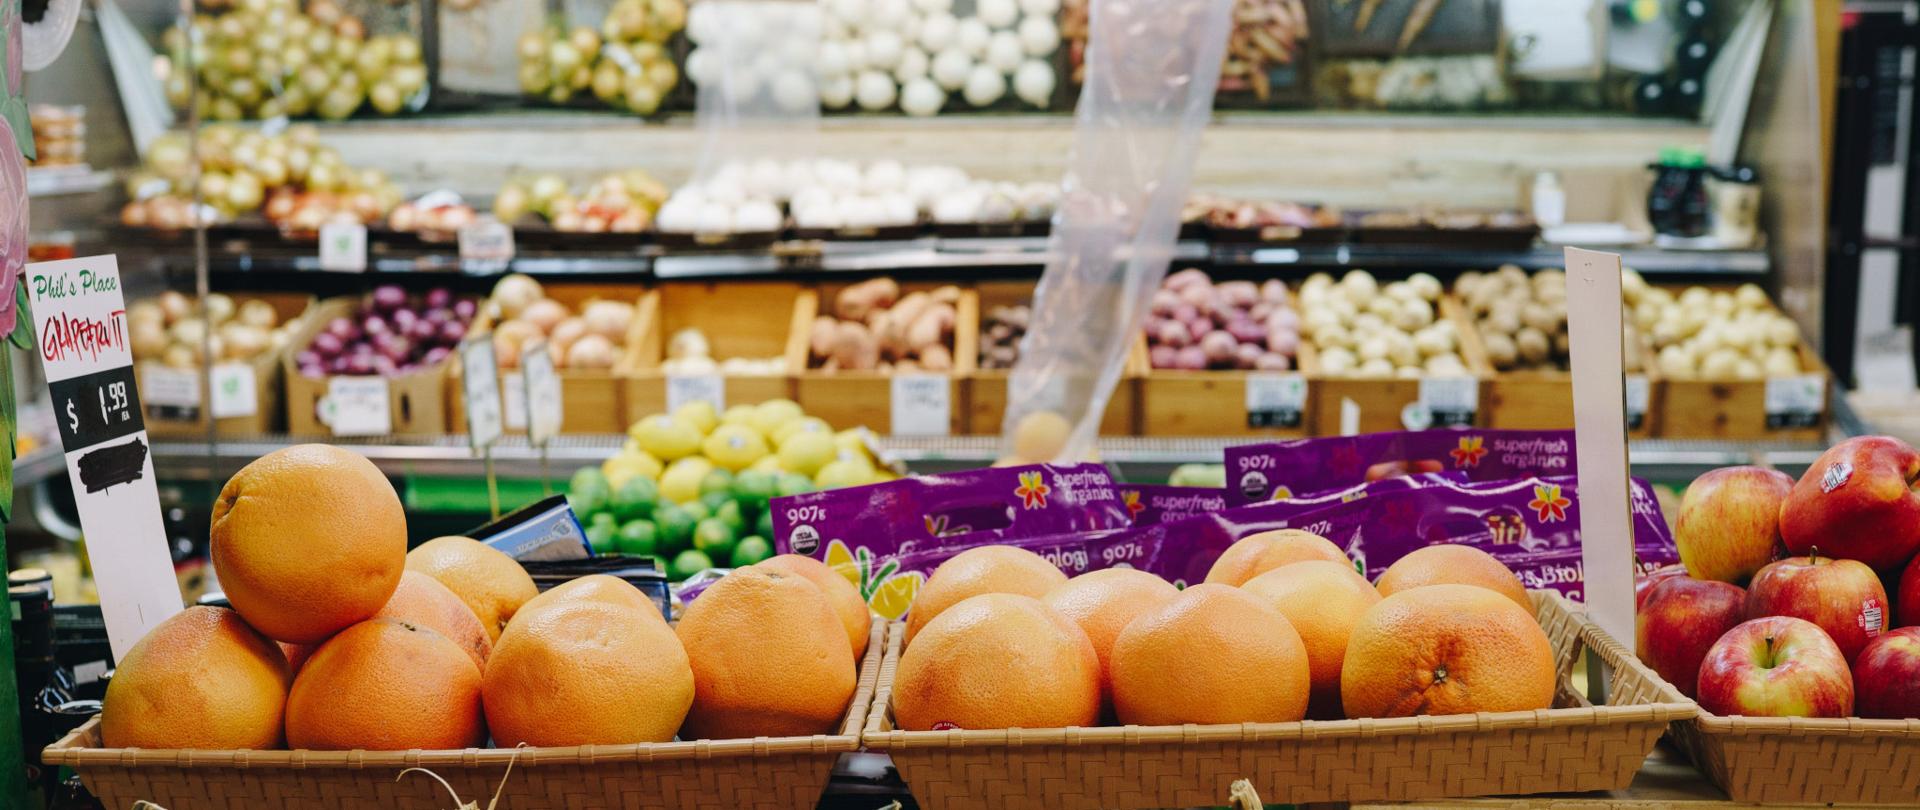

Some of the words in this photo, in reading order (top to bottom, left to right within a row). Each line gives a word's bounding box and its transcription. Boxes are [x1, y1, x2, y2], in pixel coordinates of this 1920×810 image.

[33, 272, 77, 302] Phil's
[79, 269, 117, 296] Place
[66, 398, 79, 435] $
[99, 381, 128, 425] 1.99
[1494, 437, 1568, 456] superfresh
[1239, 454, 1276, 473] 907g
[1502, 453, 1567, 469] organics
[1053, 469, 1111, 489] superfresh
[1065, 487, 1115, 506] organics
[1152, 494, 1226, 515] superfresh
[787, 505, 826, 526] 907g
[1103, 543, 1143, 566] 907g
